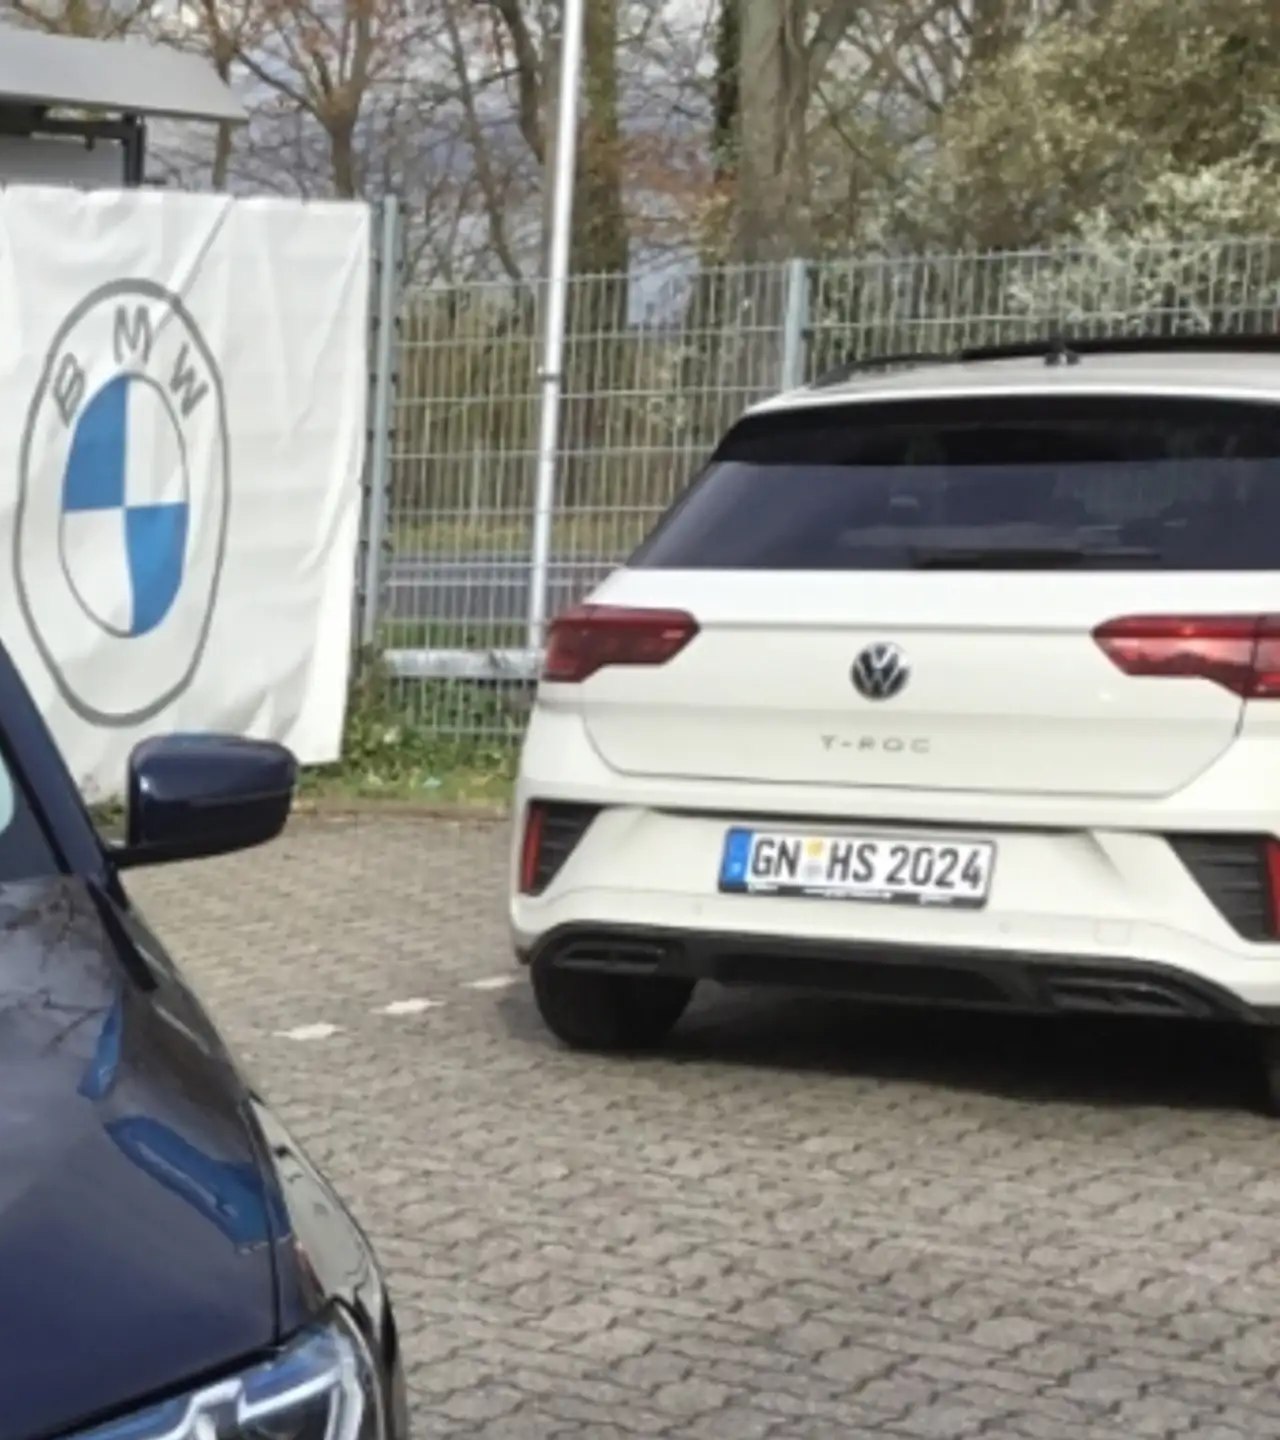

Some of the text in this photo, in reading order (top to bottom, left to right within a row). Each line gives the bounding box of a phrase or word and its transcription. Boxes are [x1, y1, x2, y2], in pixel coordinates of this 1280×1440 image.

[52, 304, 210, 429] BMW
[820, 734, 930, 753] T-ROC
[751, 838, 984, 889] GN HS 2024
